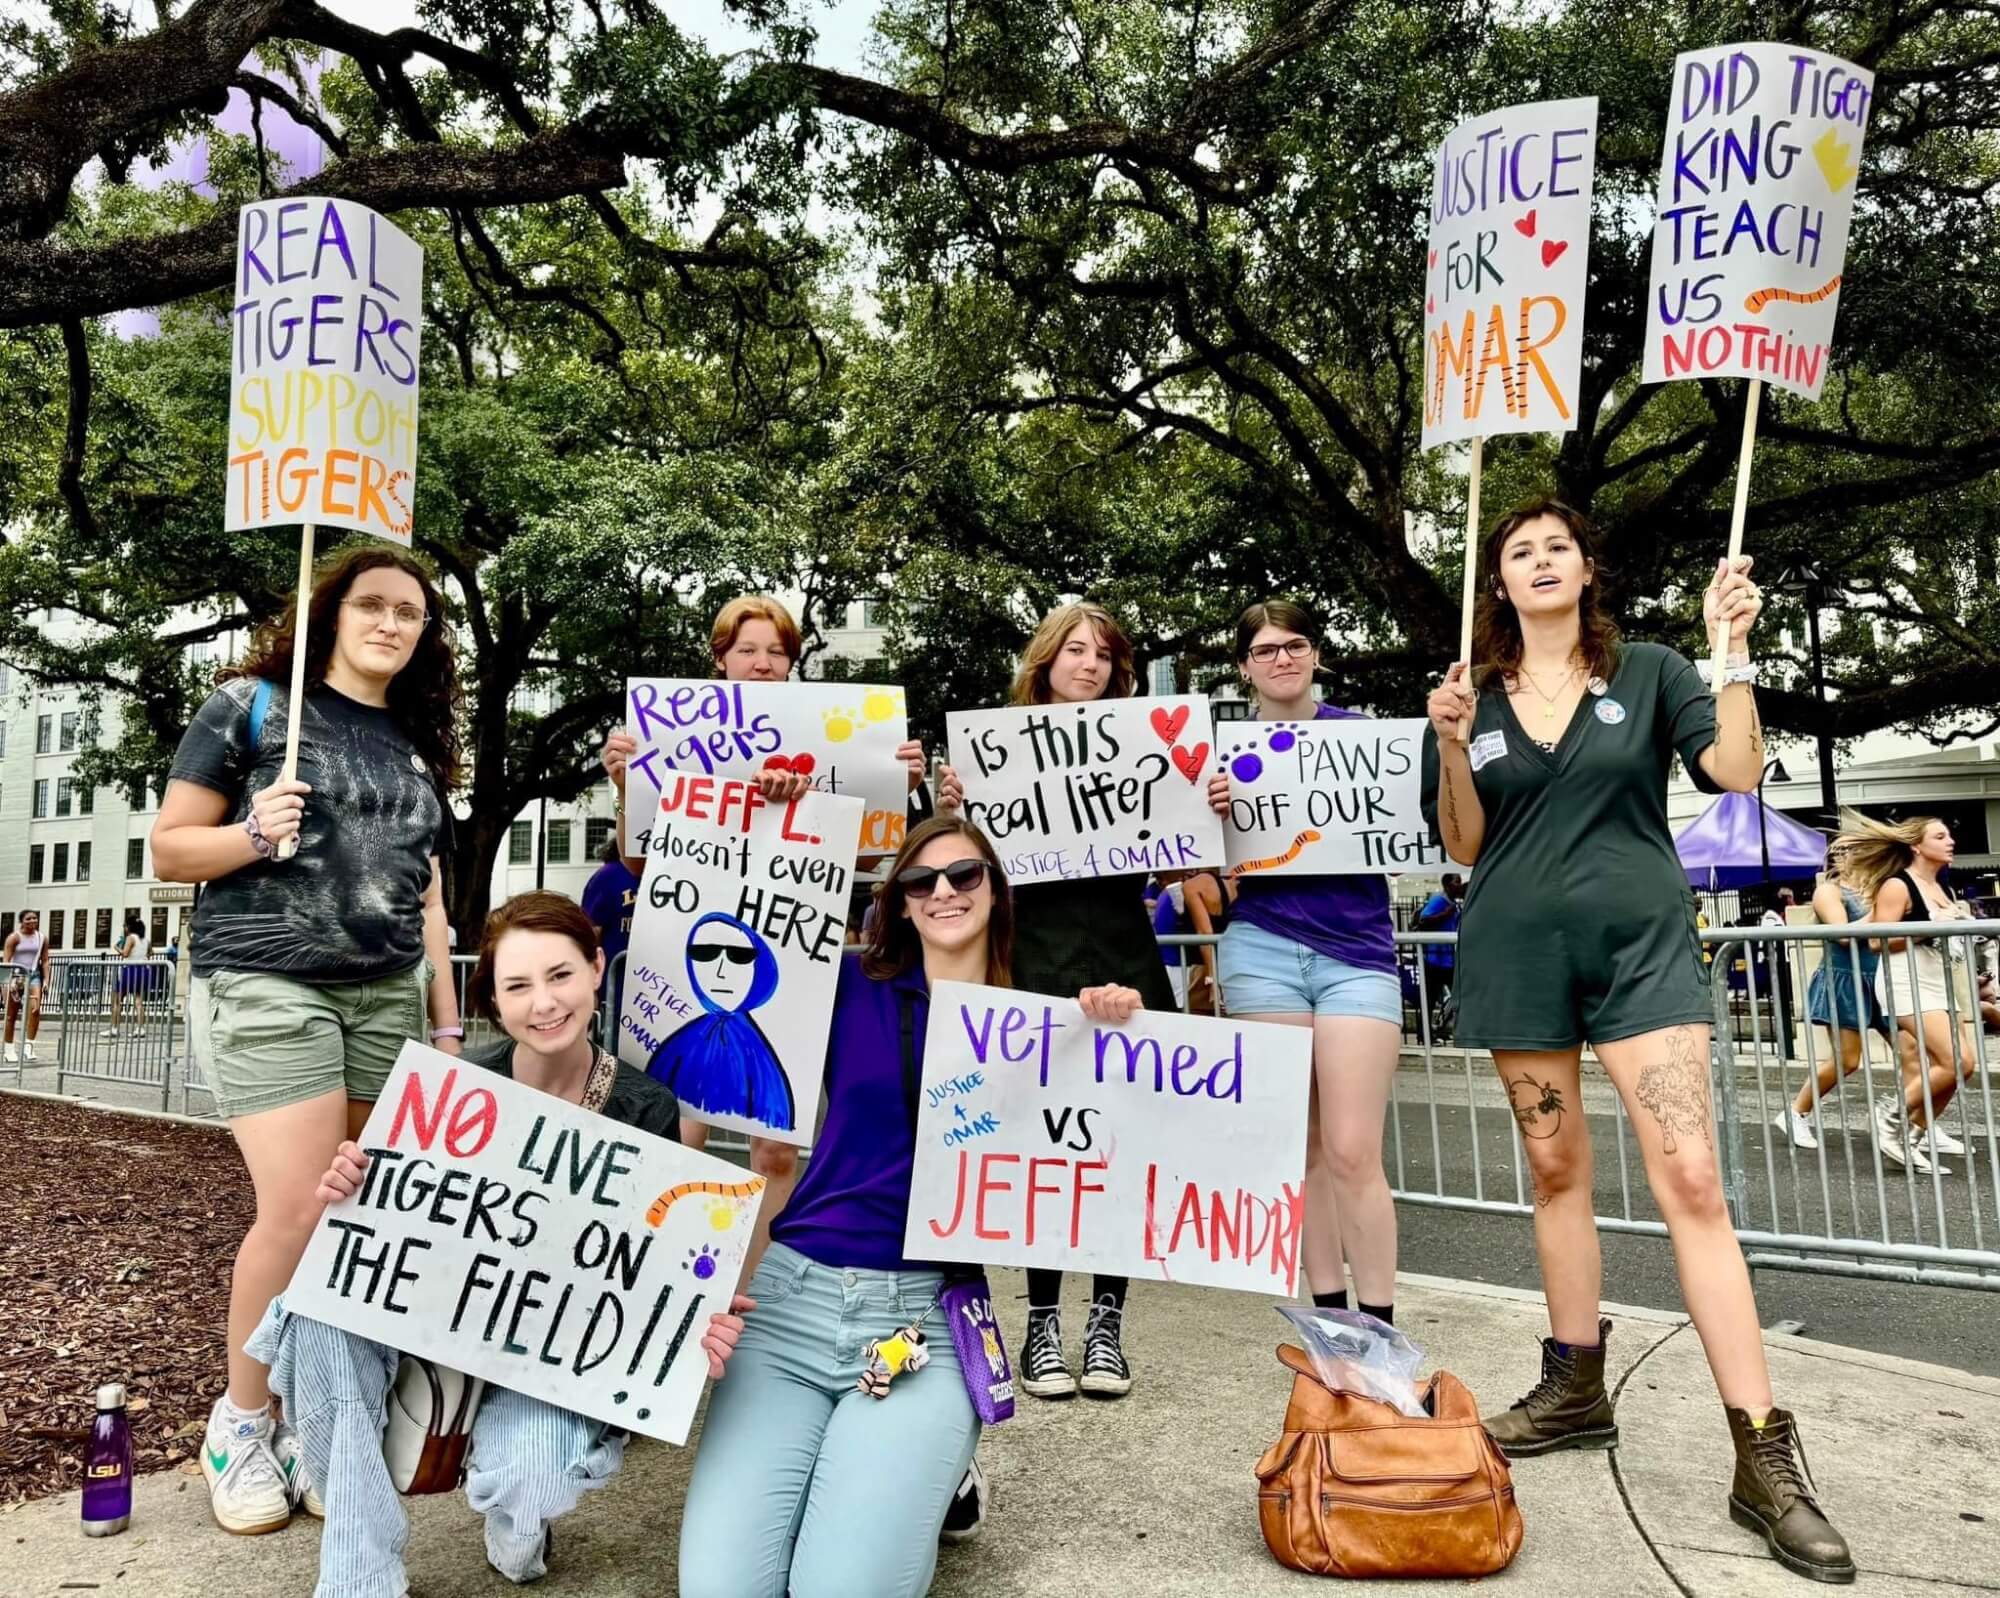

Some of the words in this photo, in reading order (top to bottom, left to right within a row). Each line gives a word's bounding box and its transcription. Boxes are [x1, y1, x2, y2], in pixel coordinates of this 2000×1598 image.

[1682, 52, 1760, 123] DID
[1673, 115, 1802, 204] KING
[243, 200, 400, 302] REAL
[1660, 199, 1823, 268] TEACH
[1658, 274, 1725, 326] US
[235, 294, 416, 385] TIGERS
[1425, 295, 1570, 427] OMAR
[230, 448, 413, 536] TIGERS
[630, 683, 744, 742] Real
[963, 728, 1008, 778] is
[1019, 707, 1120, 773] this
[1298, 737, 1410, 784] PAWS
[661, 776, 766, 833] JEFF
[781, 797, 821, 844] L.
[963, 781, 1050, 839] real
[1065, 753, 1170, 840] life?
[1231, 793, 1290, 832] OFF
[1307, 786, 1396, 827] OUR
[653, 823, 751, 878] doesn't
[769, 855, 845, 894] even
[1083, 844, 1101, 876] 4
[1108, 834, 1202, 871] OMAR
[650, 874, 699, 912] GO
[736, 885, 844, 963] HERE
[621, 1014, 660, 1053] OMAR
[1093, 1028, 1242, 1103] med
[926, 1070, 985, 1108] JUSTICE
[518, 1115, 640, 1208] LIVE
[943, 1111, 1001, 1147] OMAR
[358, 1148, 551, 1247] TIGERS
[574, 1219, 655, 1291] ON
[928, 1150, 1108, 1248] JEFF
[1144, 1163, 1305, 1297] LANDRY
[326, 1218, 432, 1314] THE
[961, 1298, 993, 1328] LSU
[88, 1463, 121, 1478] LSU
